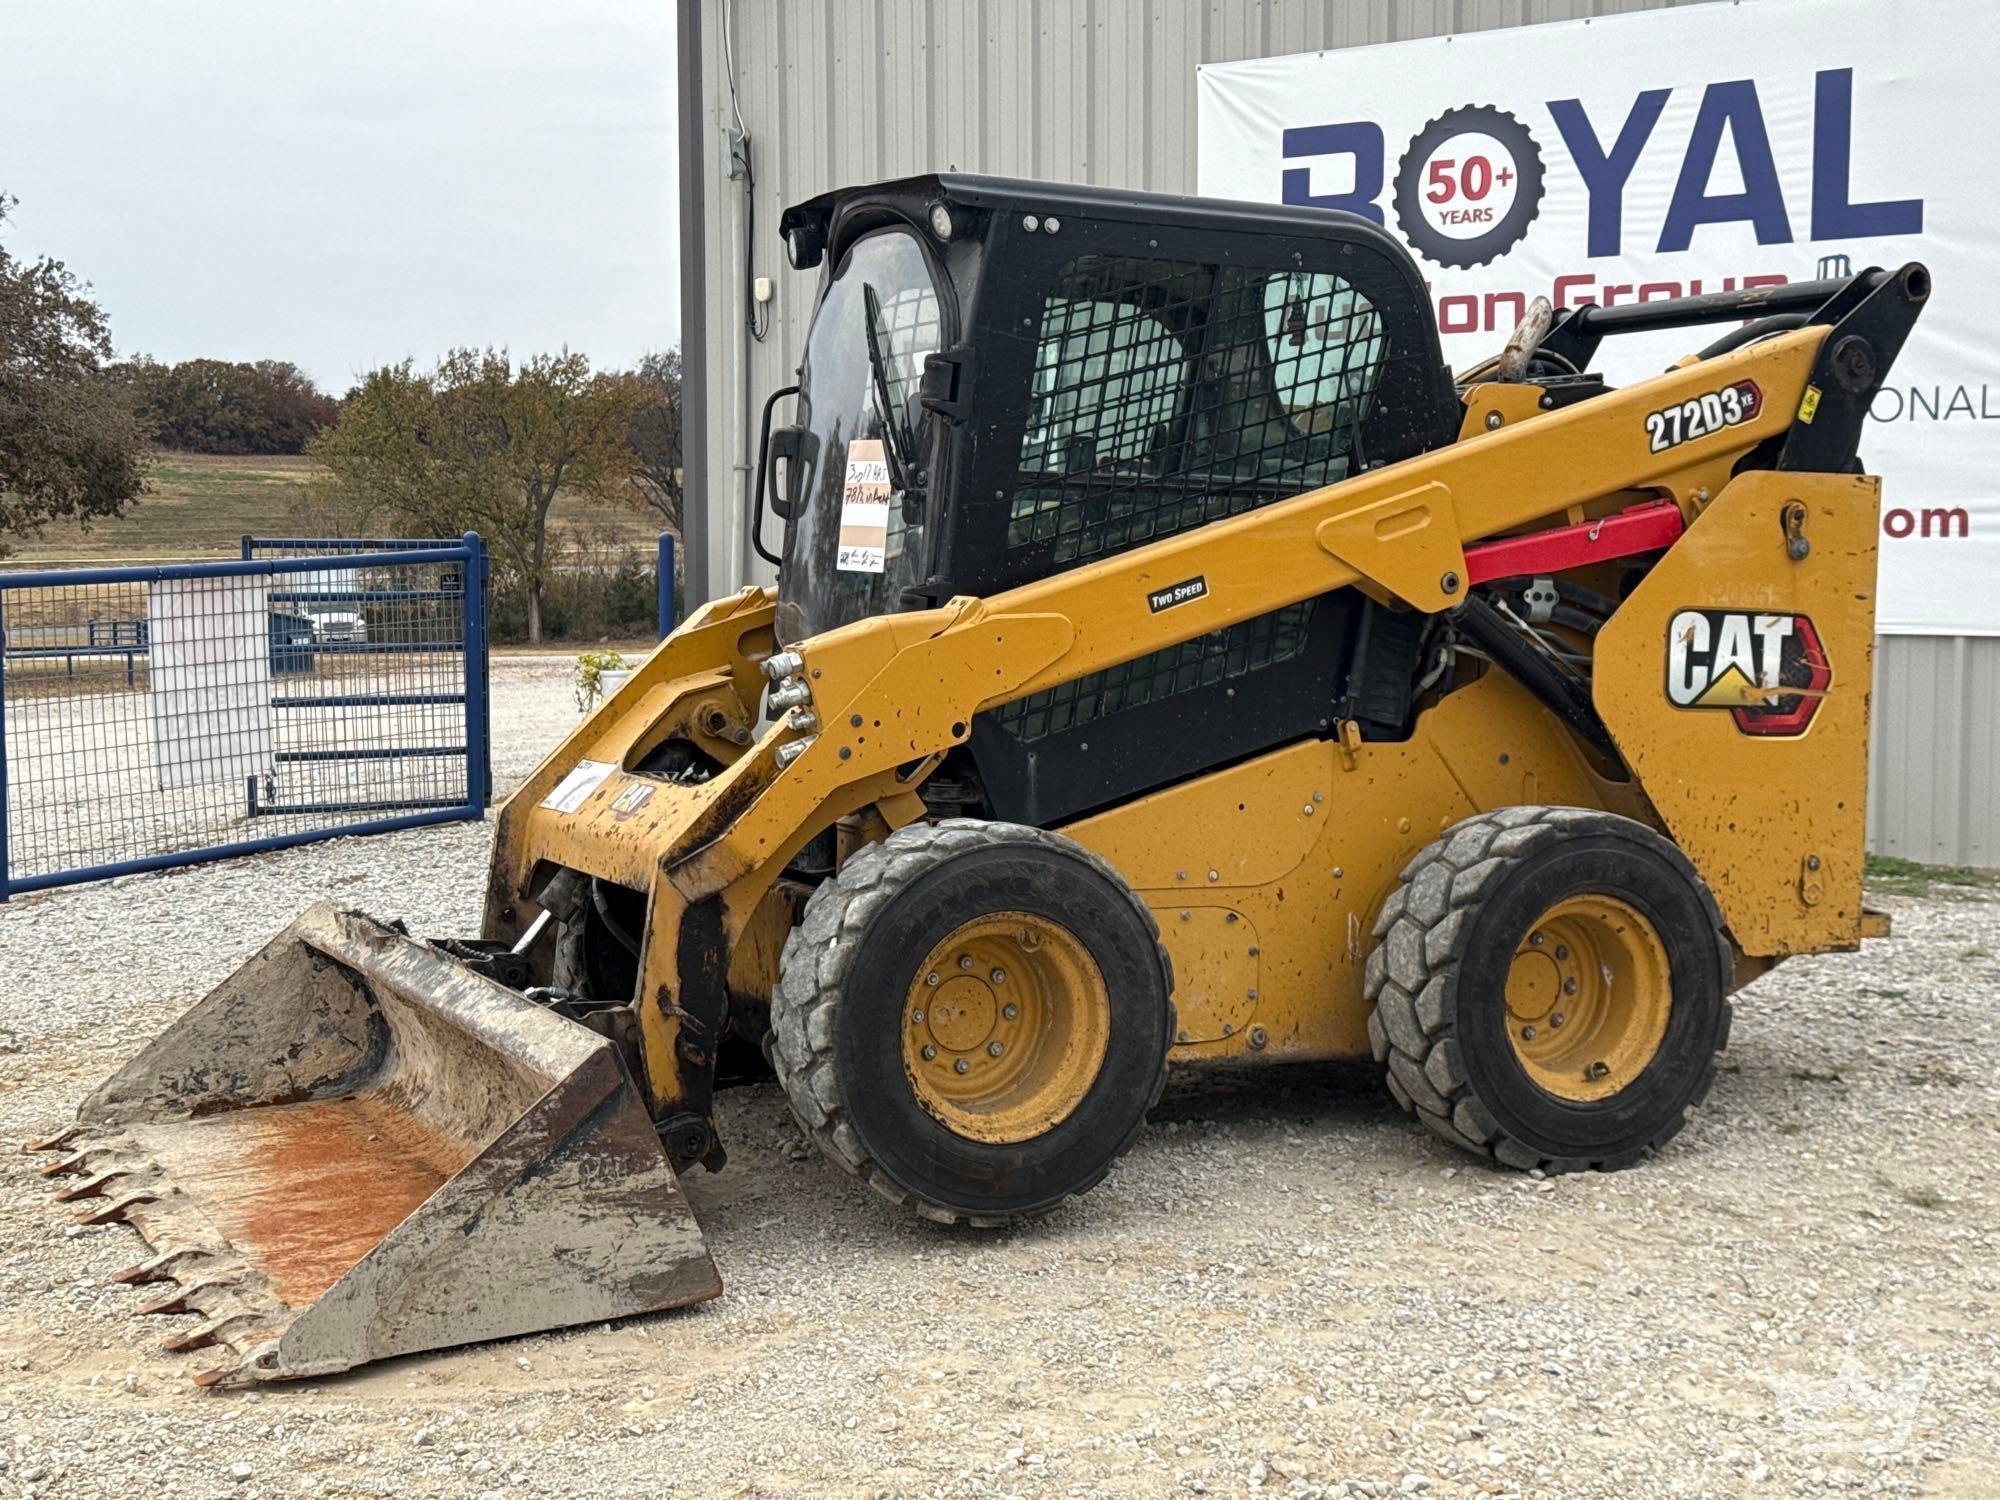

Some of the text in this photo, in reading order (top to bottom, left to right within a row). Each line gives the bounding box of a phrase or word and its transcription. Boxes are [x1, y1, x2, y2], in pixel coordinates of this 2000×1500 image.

[1426, 155, 1514, 204] 50+
[1439, 207, 1494, 225] YEARS
[1646, 387, 1755, 453] 272D3 XE
[1669, 611, 1793, 706] CAT
[611, 782, 656, 814] CAT
